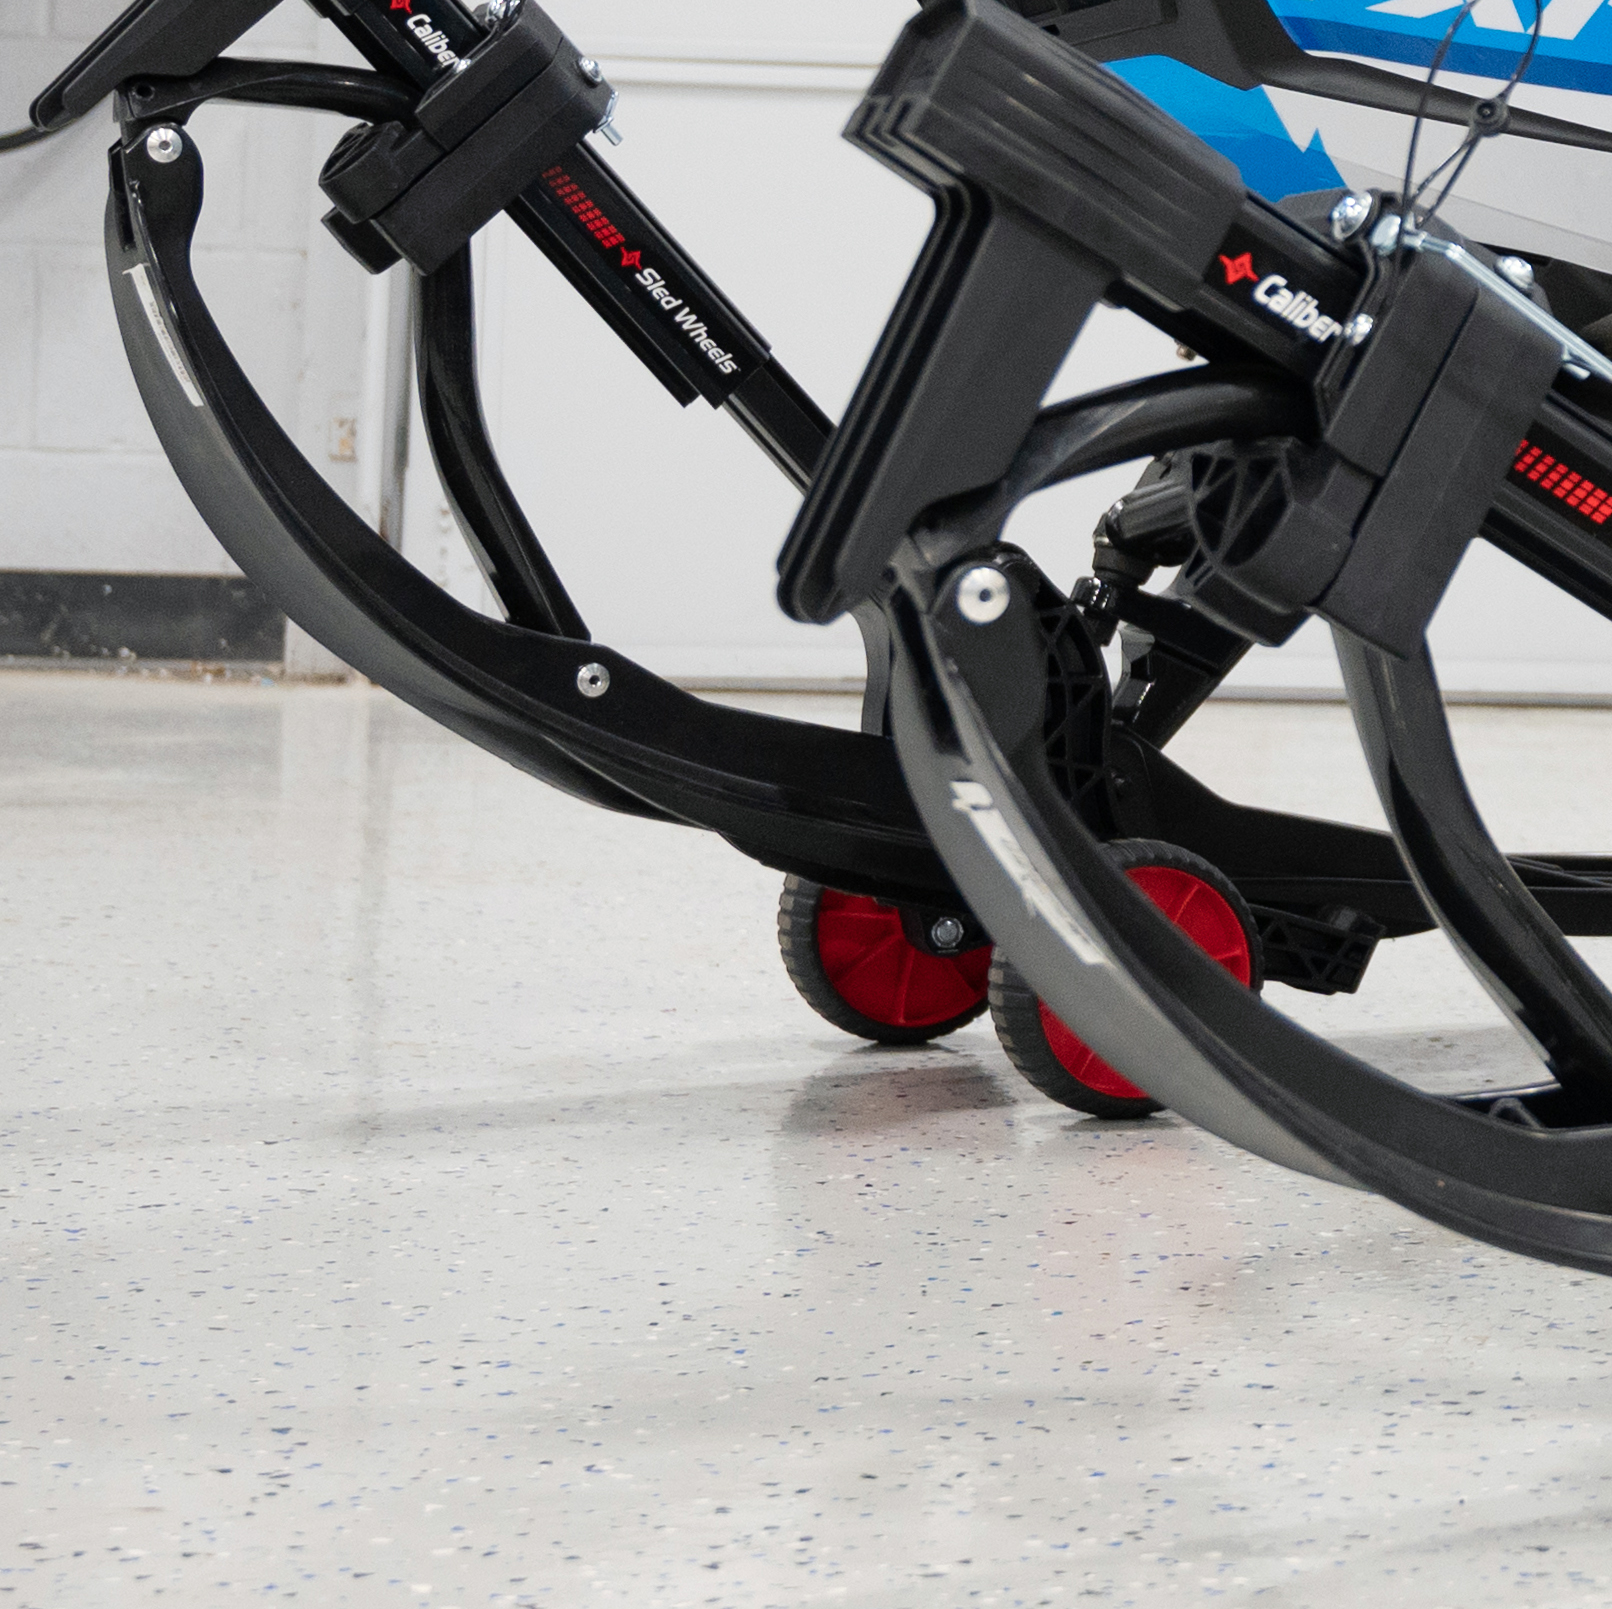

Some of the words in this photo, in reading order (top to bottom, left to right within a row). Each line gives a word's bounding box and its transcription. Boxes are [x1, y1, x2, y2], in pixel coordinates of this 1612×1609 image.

[406, 13, 461, 68] Caliber
[635, 267, 683, 311] Sled
[674, 306, 738, 374] Wheels
[1252, 274, 1343, 343] Caliber
